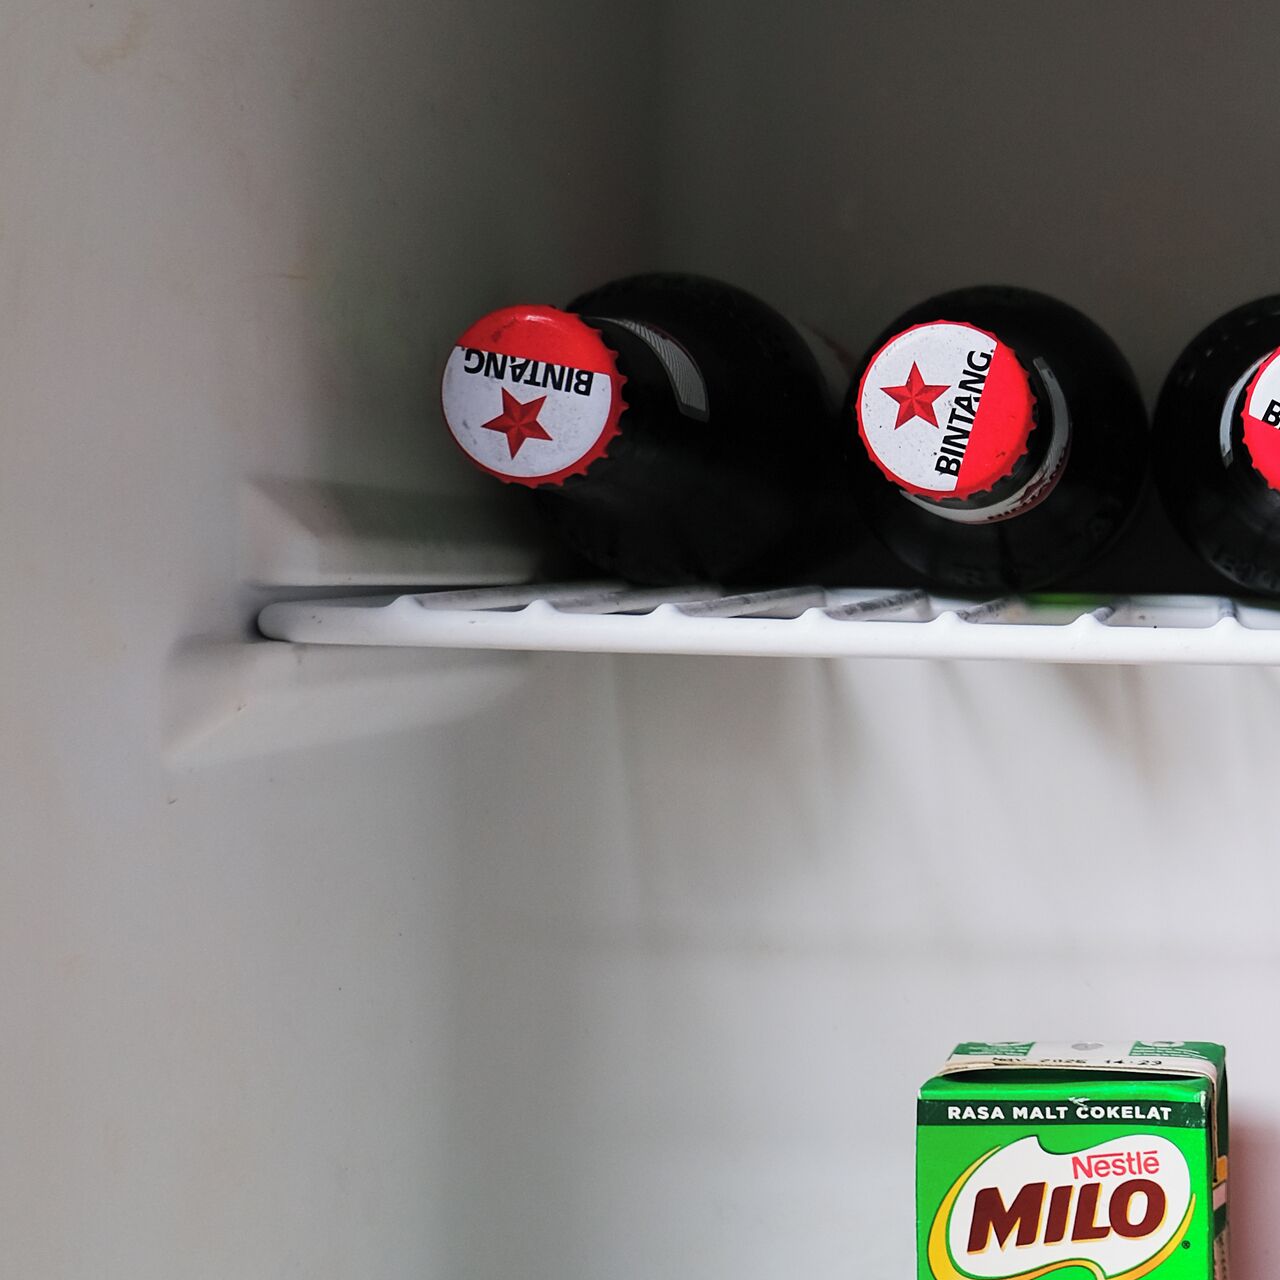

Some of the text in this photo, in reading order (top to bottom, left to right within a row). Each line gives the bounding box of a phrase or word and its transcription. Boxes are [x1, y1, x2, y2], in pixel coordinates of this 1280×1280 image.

[464, 347, 593, 396] BINTANG
[935, 349, 993, 478] BINTANG
[948, 1105, 1172, 1121] RASA MALT COKELAT
[967, 1179, 1166, 1254] MILO
